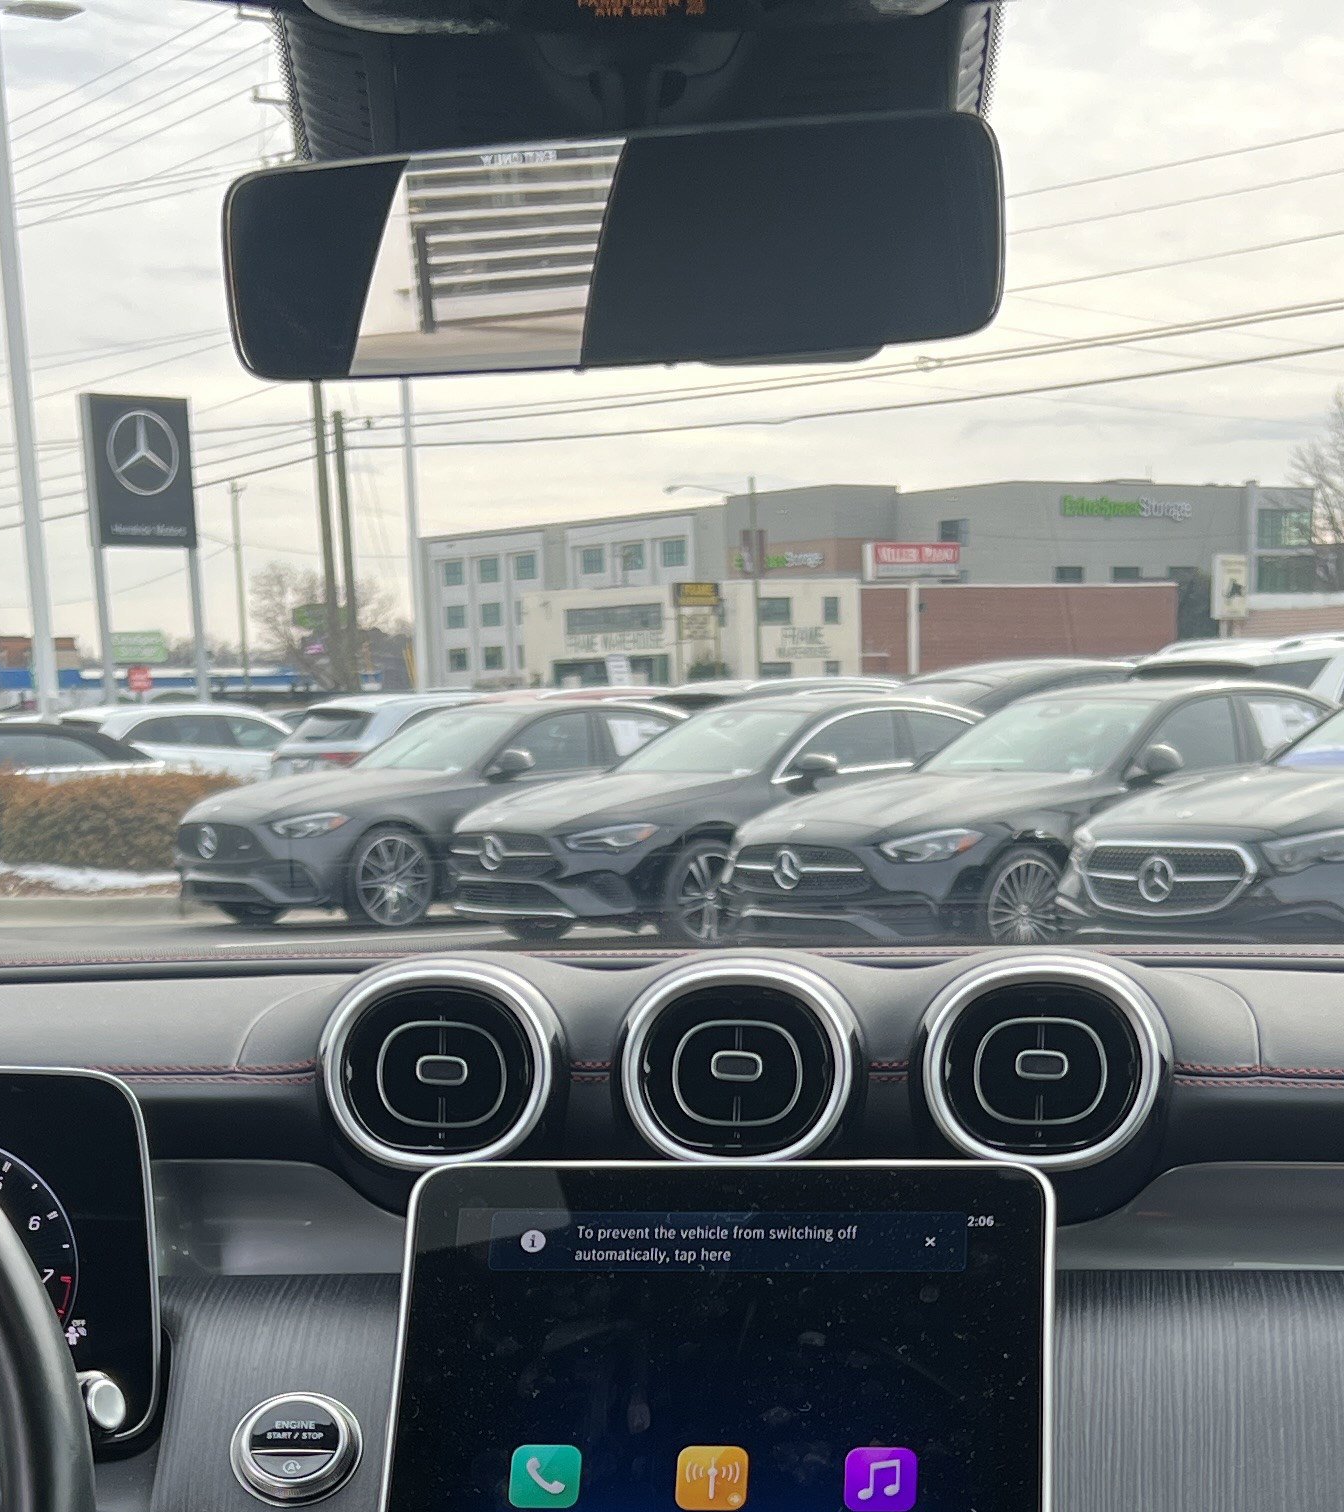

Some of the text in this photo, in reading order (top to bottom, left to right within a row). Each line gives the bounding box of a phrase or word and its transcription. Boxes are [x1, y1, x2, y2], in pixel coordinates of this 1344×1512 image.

[28, 1215, 41, 1232] 6
[967, 1215, 995, 1227] 2:06
[576, 1225, 857, 1245] To prevent the vehicle from switching off
[574, 1247, 731, 1265] automatically, tap here
[274, 1420, 316, 1430] ENGINE
[266, 1432, 292, 1440] START
[302, 1432, 324, 1440] STOP
